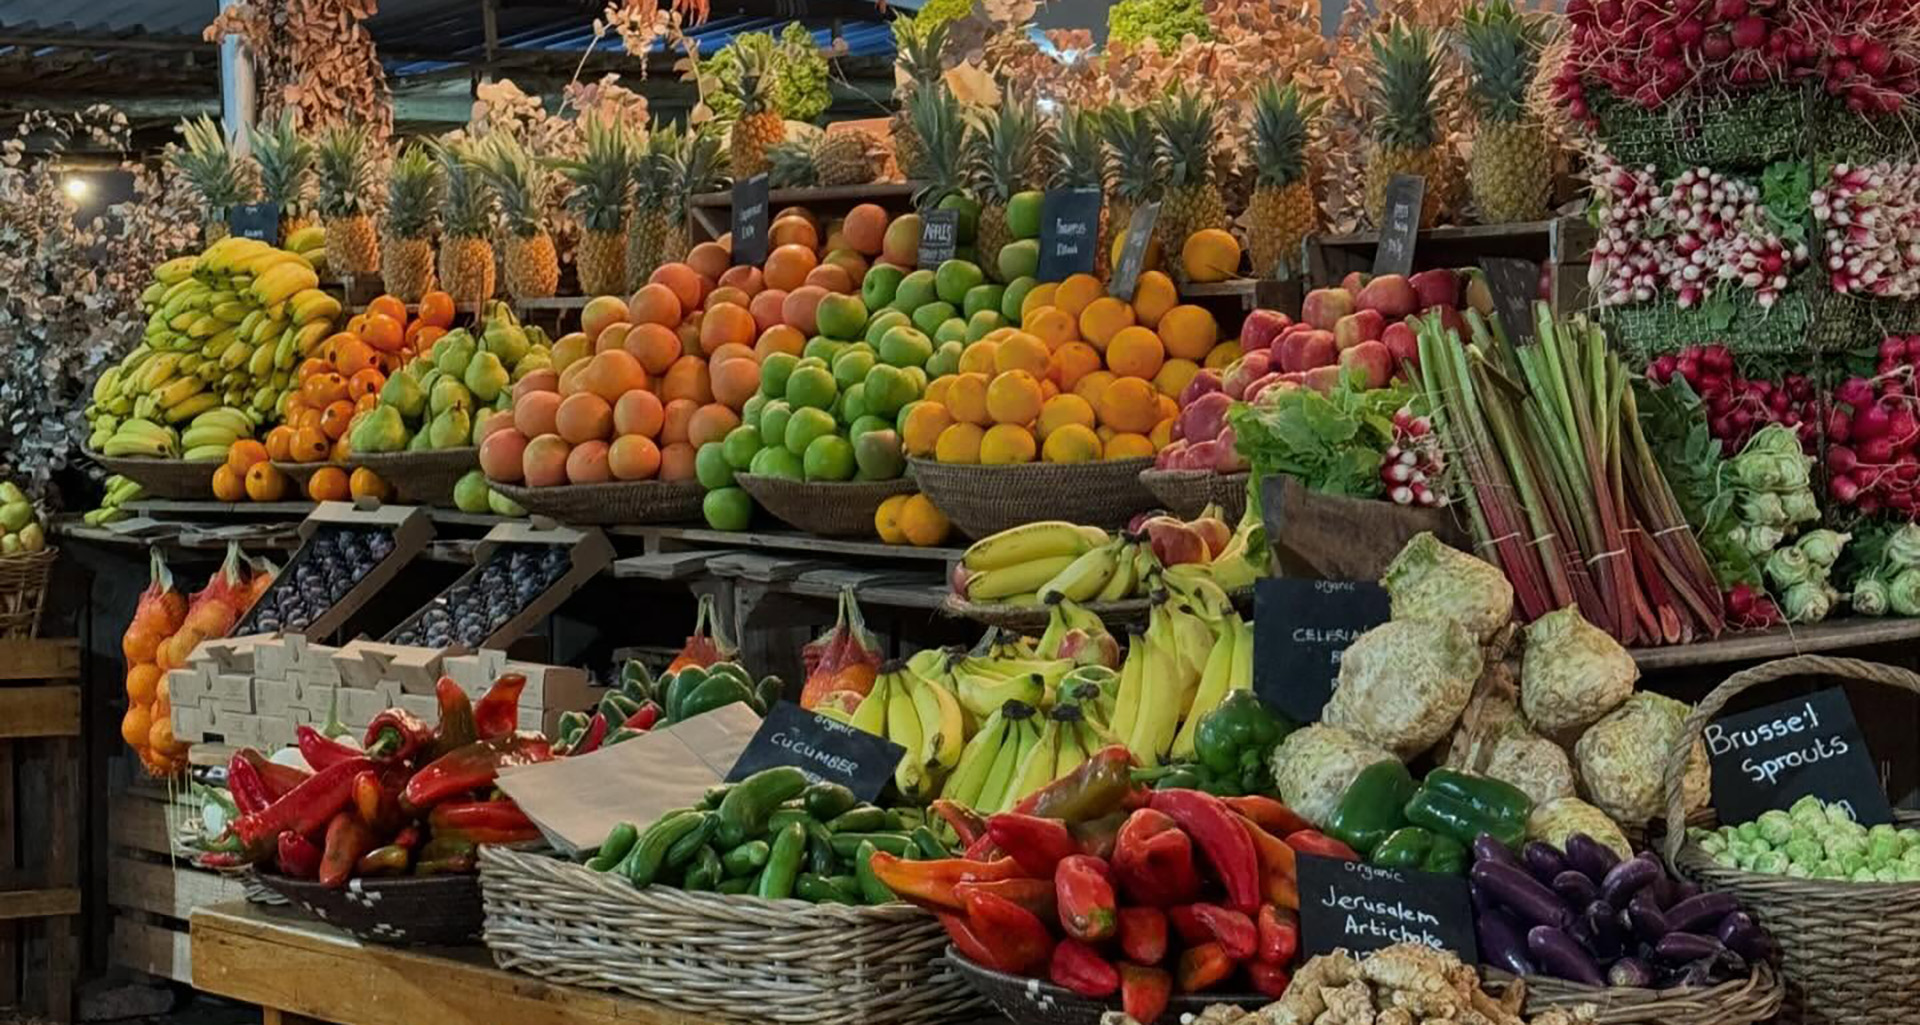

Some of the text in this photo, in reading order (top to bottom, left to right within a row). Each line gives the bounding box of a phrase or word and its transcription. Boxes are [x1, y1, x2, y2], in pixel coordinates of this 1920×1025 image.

[923, 223, 952, 241] APPLES
[1314, 581, 1355, 594] organic
[814, 705, 857, 737] organic
[1704, 702, 1819, 756] Brussel
[770, 732, 859, 776] CUCUMBER
[1741, 735, 1849, 785] Sprouts
[1344, 861, 1405, 883] organic
[1321, 885, 1440, 926] Jerusalem
[1344, 914, 1444, 951] Artichoke
